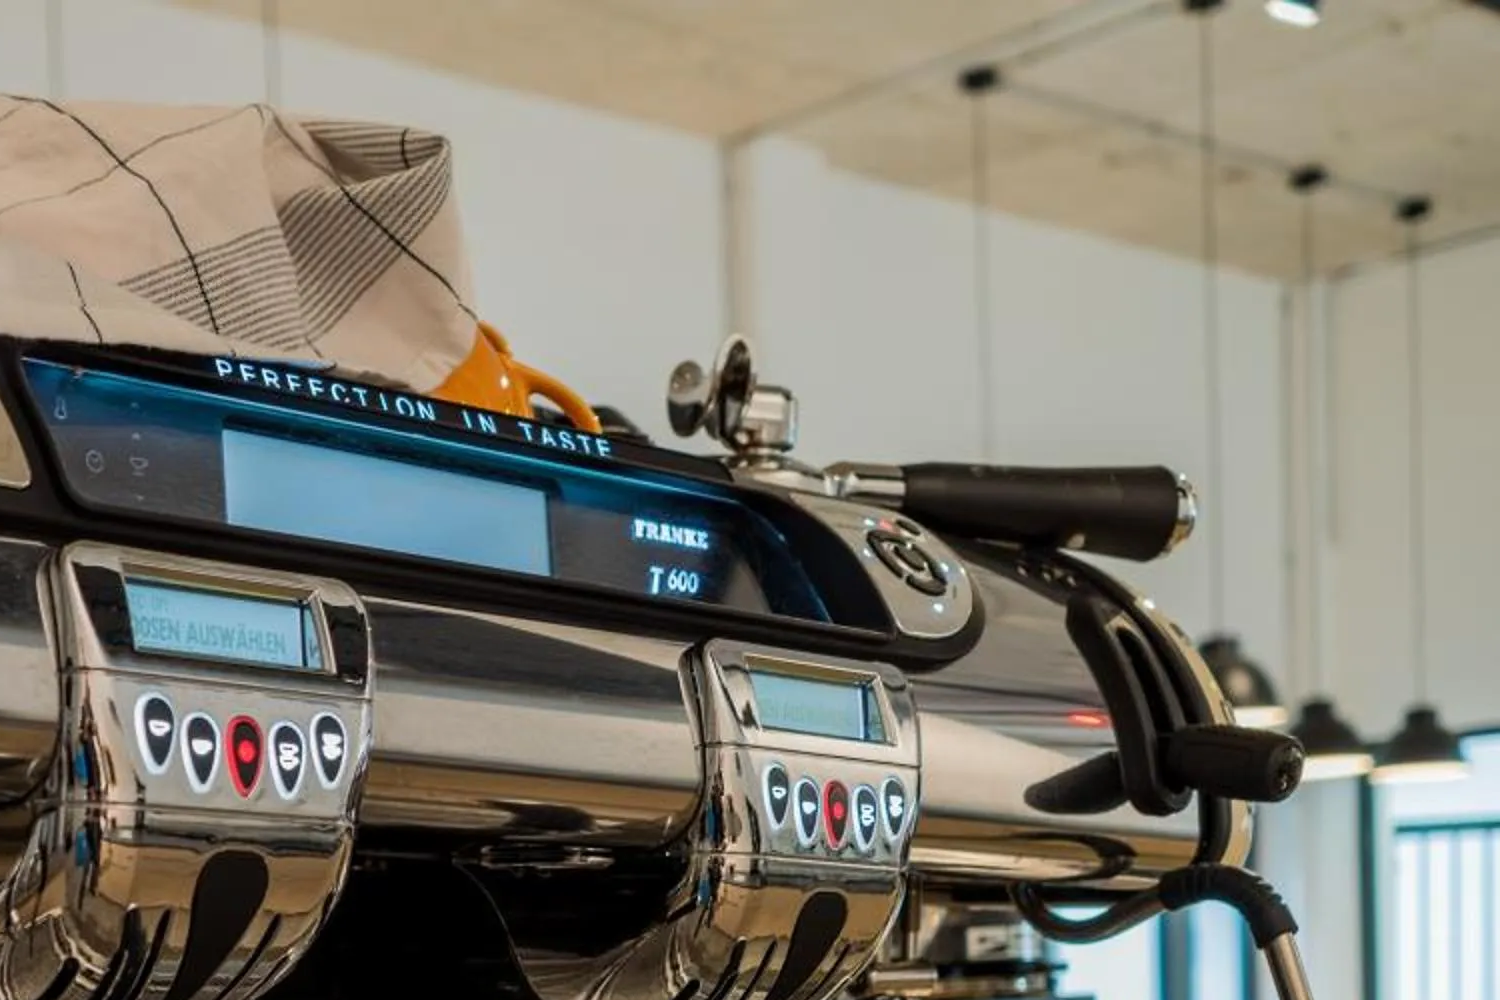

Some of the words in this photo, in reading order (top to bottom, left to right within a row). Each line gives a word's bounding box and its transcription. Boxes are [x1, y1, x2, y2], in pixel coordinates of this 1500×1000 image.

[215, 358, 436, 421] PERFECTION
[461, 409, 498, 434] IN
[517, 421, 612, 457] TASTE
[634, 518, 709, 550] FRANKE
[649, 566, 664, 594] T
[668, 568, 700, 594] 600
